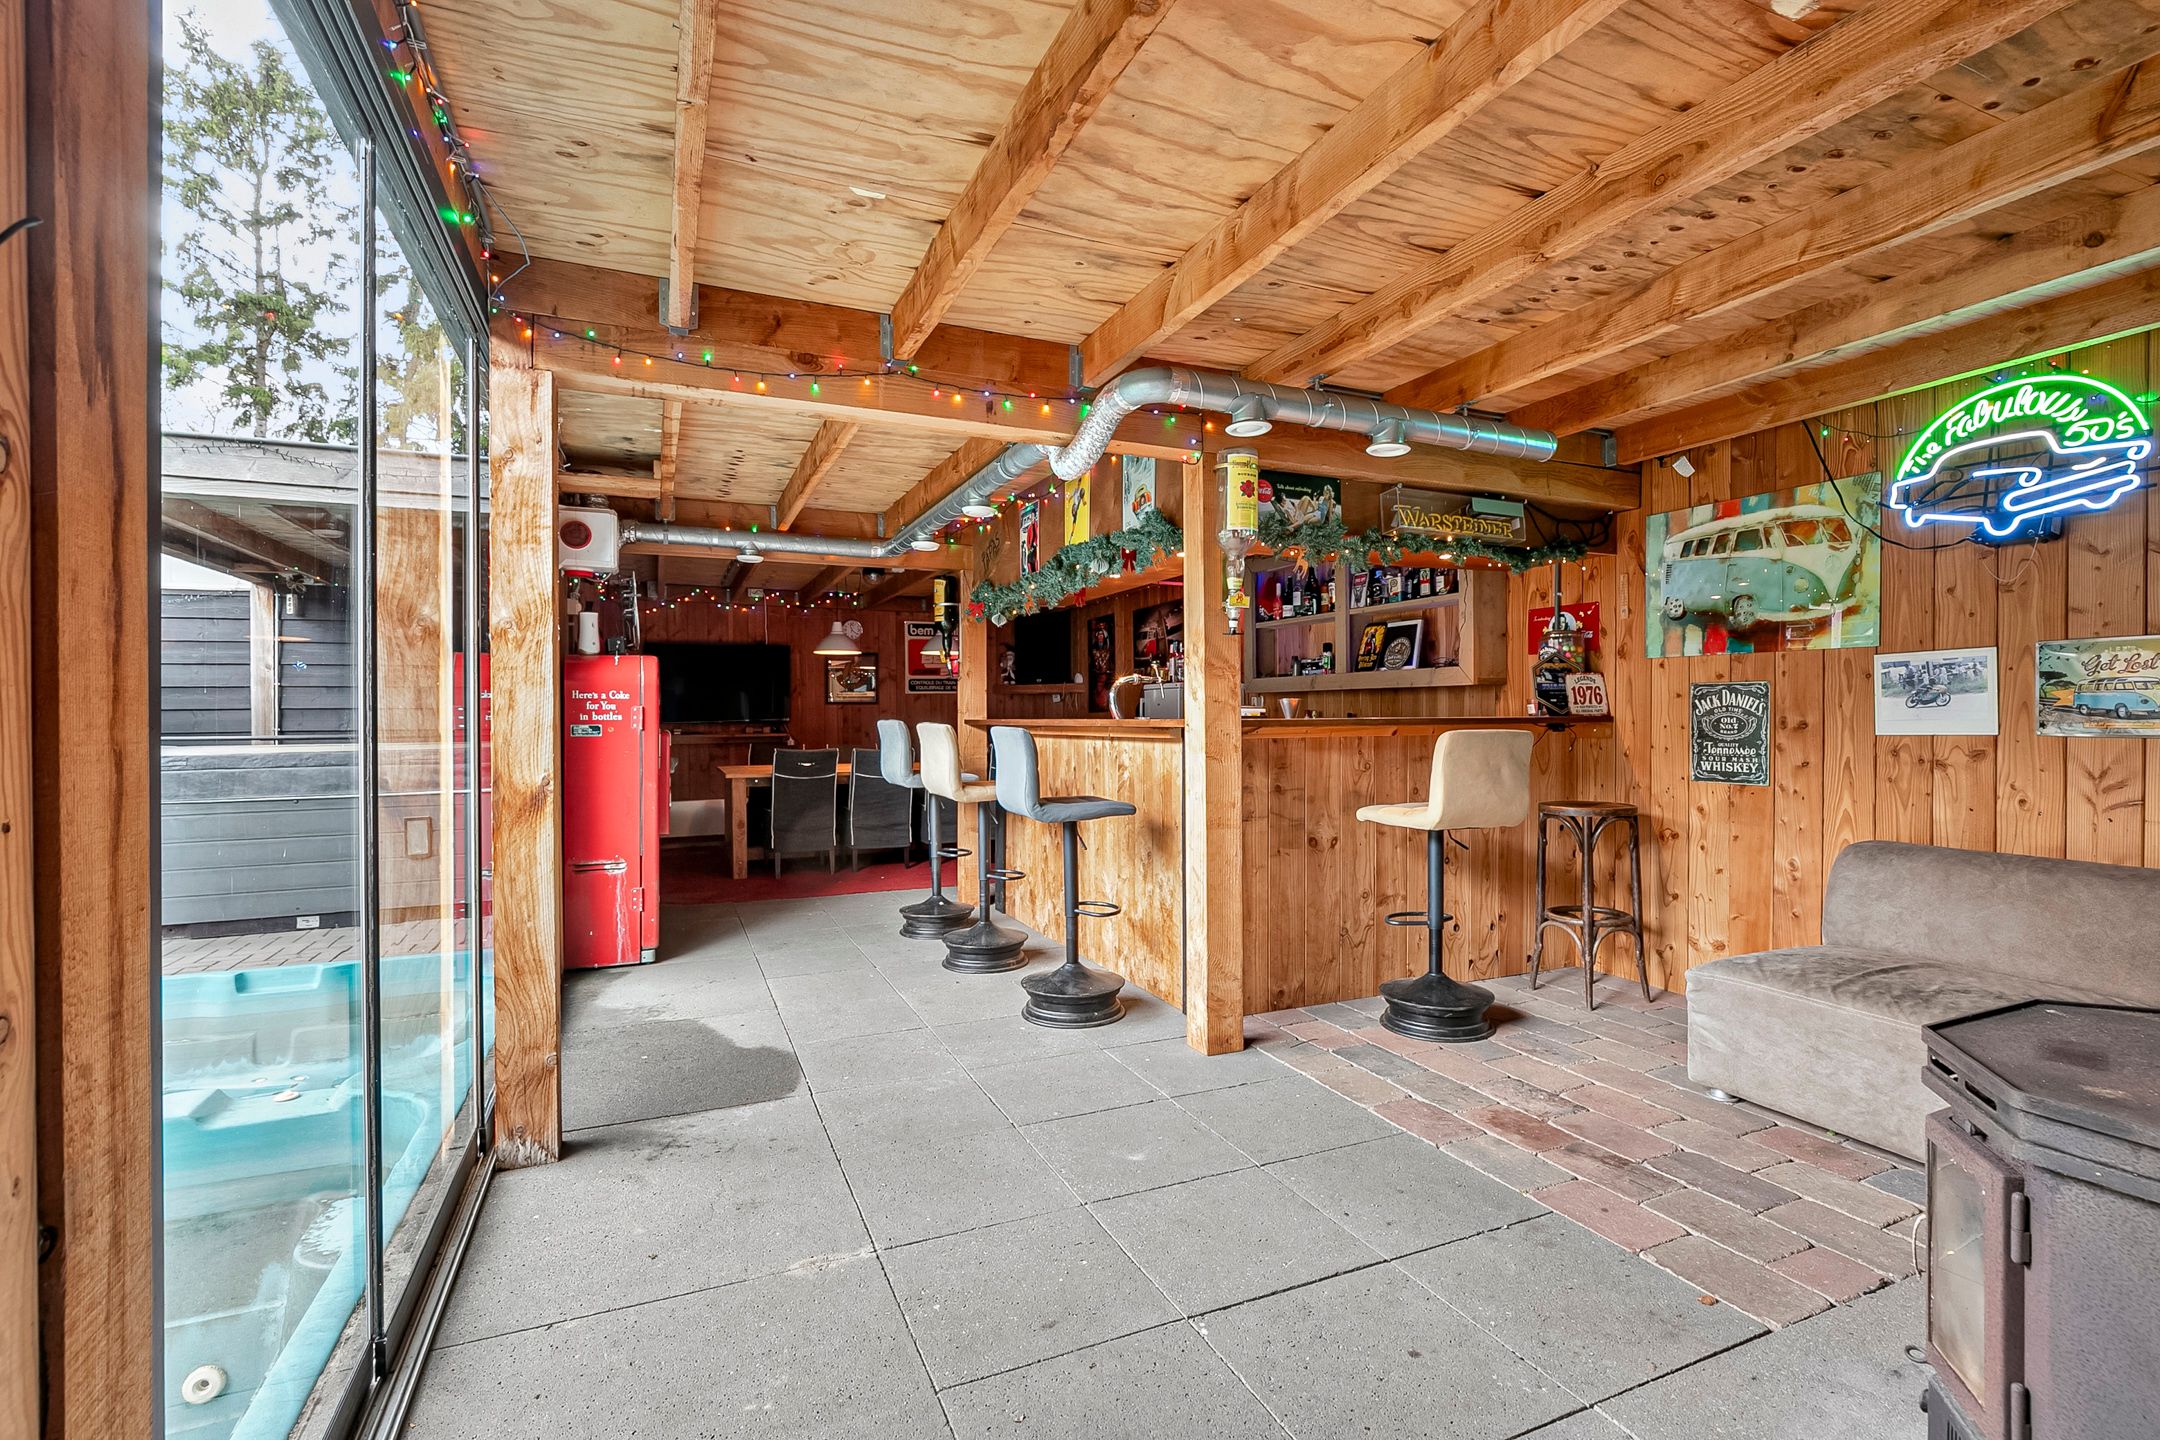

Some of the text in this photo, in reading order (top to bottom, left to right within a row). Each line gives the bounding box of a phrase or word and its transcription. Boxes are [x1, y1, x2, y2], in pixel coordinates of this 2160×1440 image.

[1905, 384, 2136, 474] The Fabulous 50's
[1393, 504, 1513, 539] WARSTEINER
[2081, 652, 2160, 677] Get Lost
[571, 689, 598, 699] Here's
[608, 689, 630, 700] Coke
[1570, 685, 1604, 706] 1976
[586, 700, 617, 710] for You
[1694, 693, 1721, 716] JACK
[579, 711, 623, 721] in bottles
[1702, 741, 1757, 756] Tennessee
[1700, 761, 1759, 773] WHISKEY
